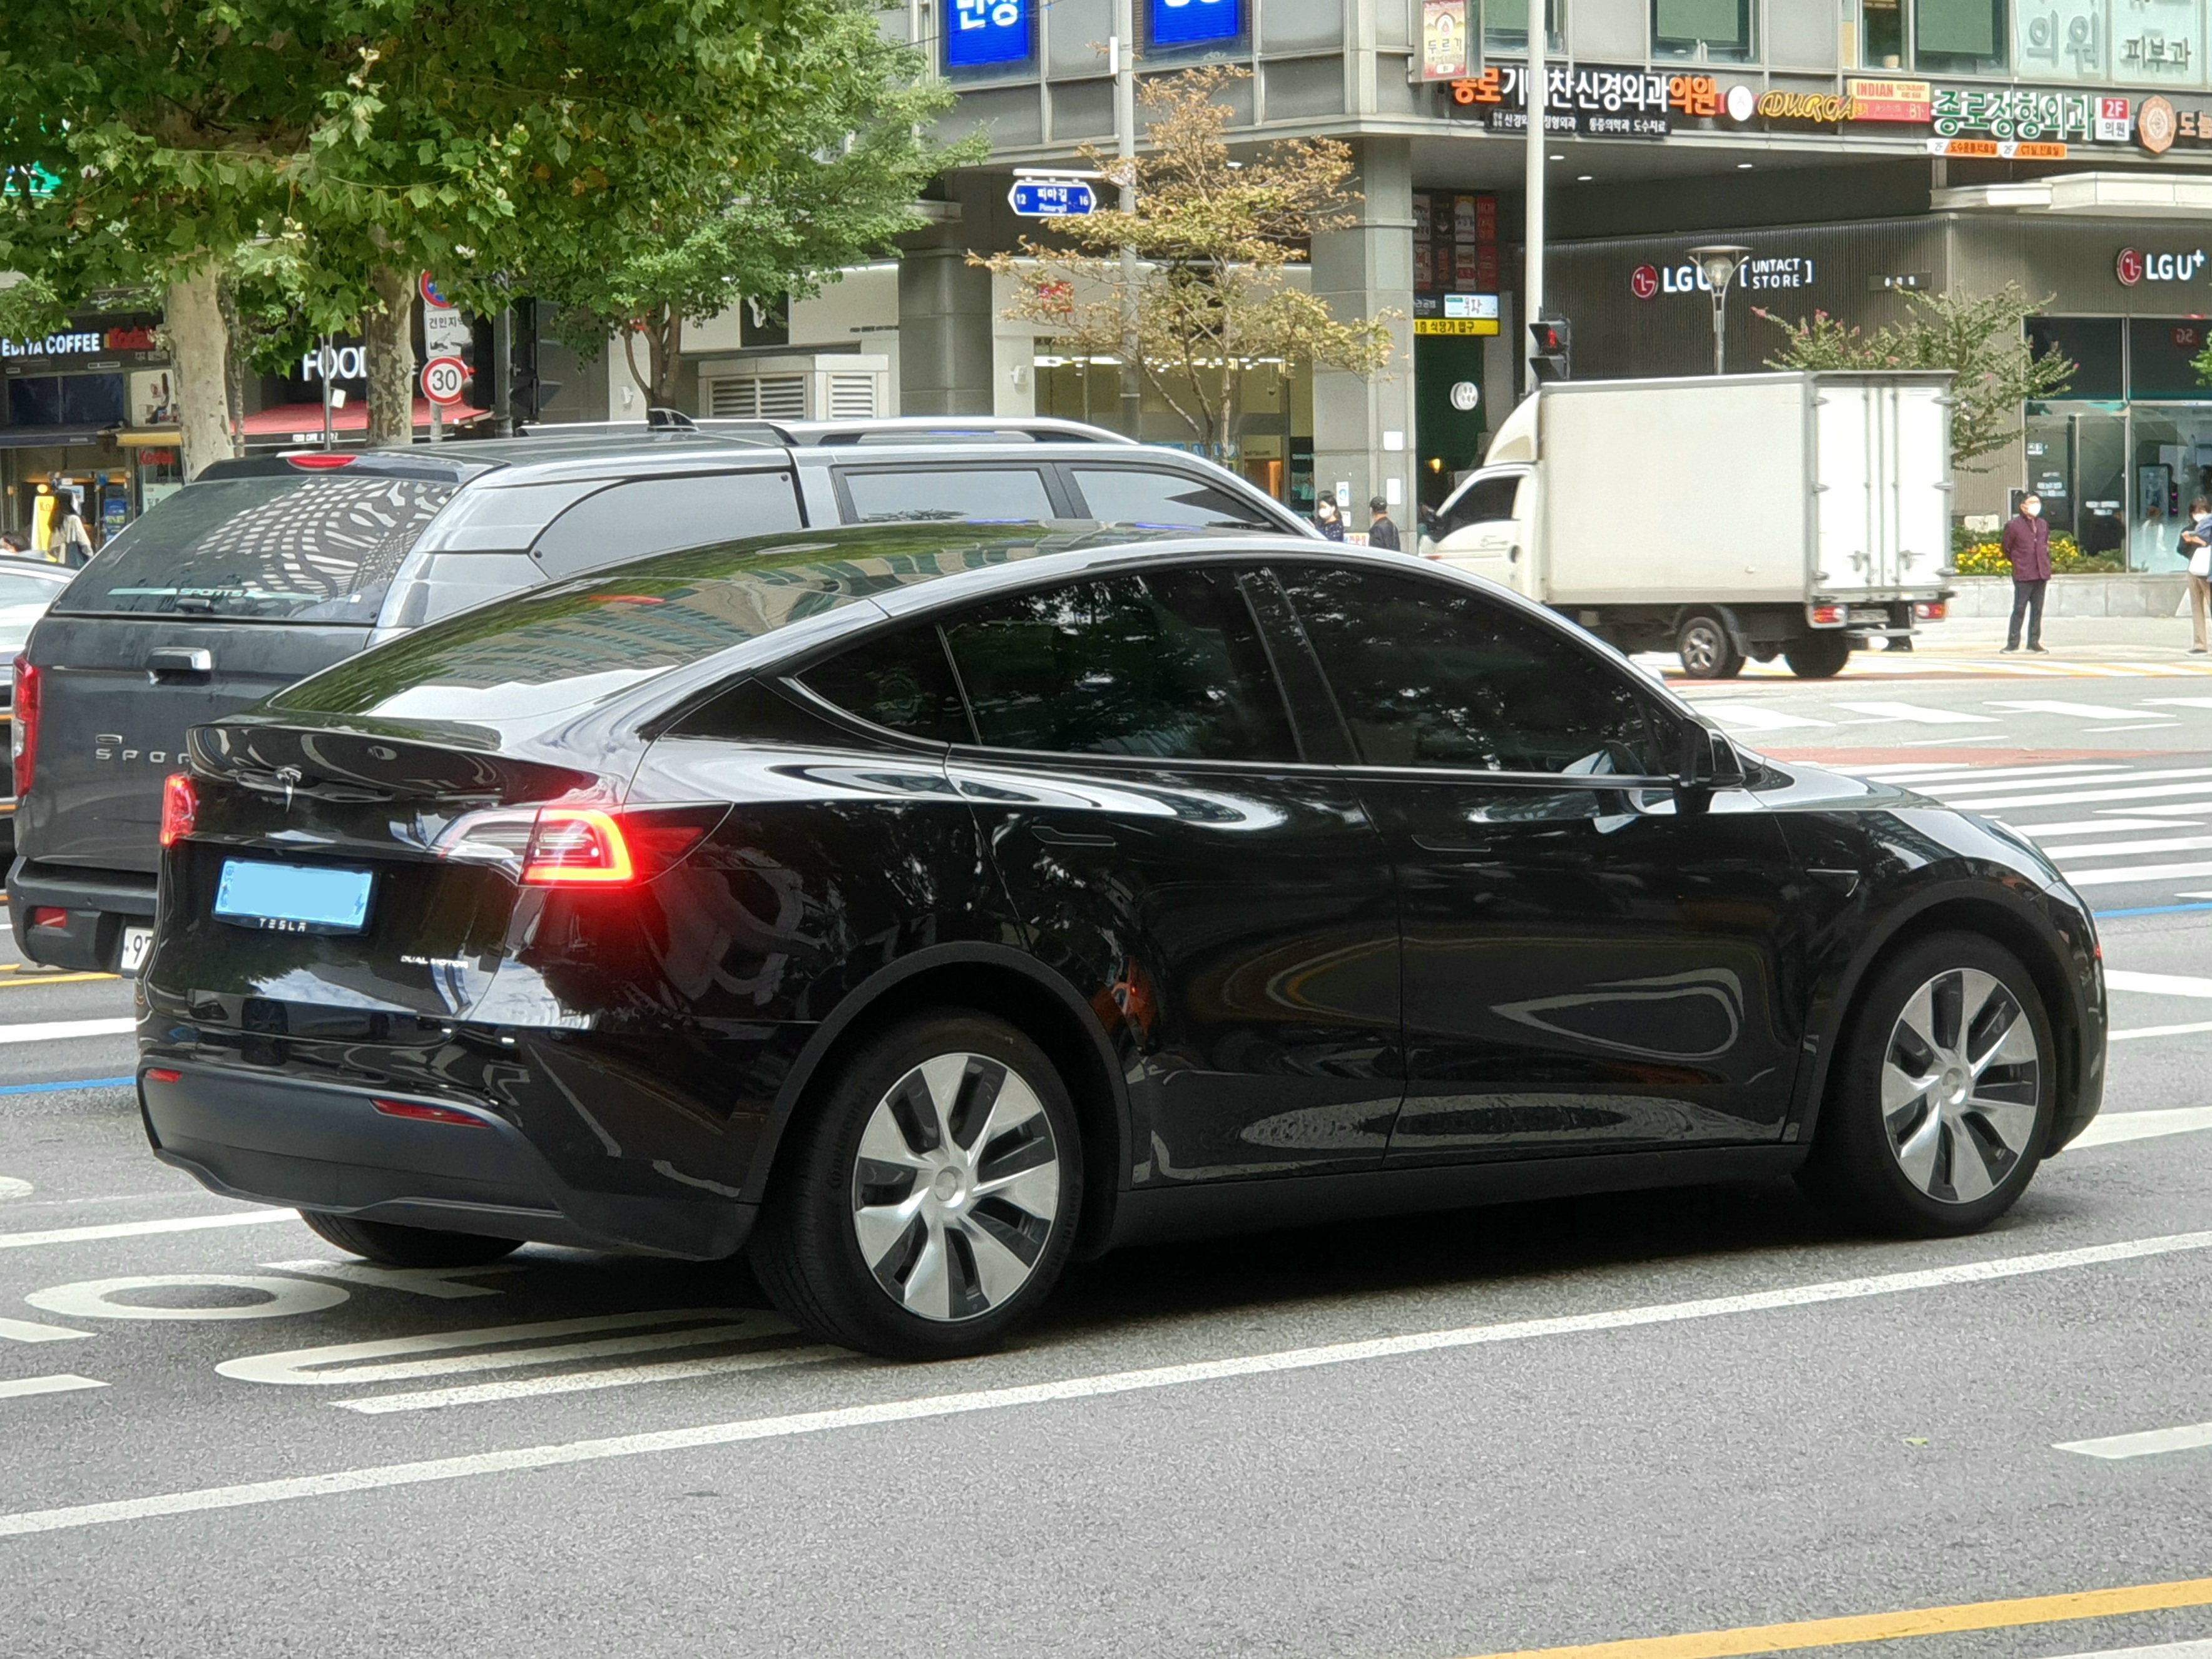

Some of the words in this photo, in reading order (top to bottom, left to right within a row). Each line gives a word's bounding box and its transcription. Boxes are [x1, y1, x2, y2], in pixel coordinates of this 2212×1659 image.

[2027, 9, 2101, 78] 의원
[2123, 35, 2192, 73] 피부과
[1857, 82, 1893, 98] INDIAN
[1758, 89, 1857, 123] DURGA
[2106, 101, 2124, 117] 2F
[1932, 89, 2094, 141] 종로정형외과
[2104, 121, 2125, 137] 의원
[1017, 193, 1027, 205] 12
[1079, 195, 1089, 206] 16
[1752, 258, 1800, 273] UNTACT
[1753, 274, 1800, 290] STORE
[46, 333, 100, 354] COFFEE
[432, 369, 457, 391] 30
[259, 917, 307, 932] TESLA
[400, 954, 429, 964] DUAL
[430, 958, 469, 969] MOTOR
